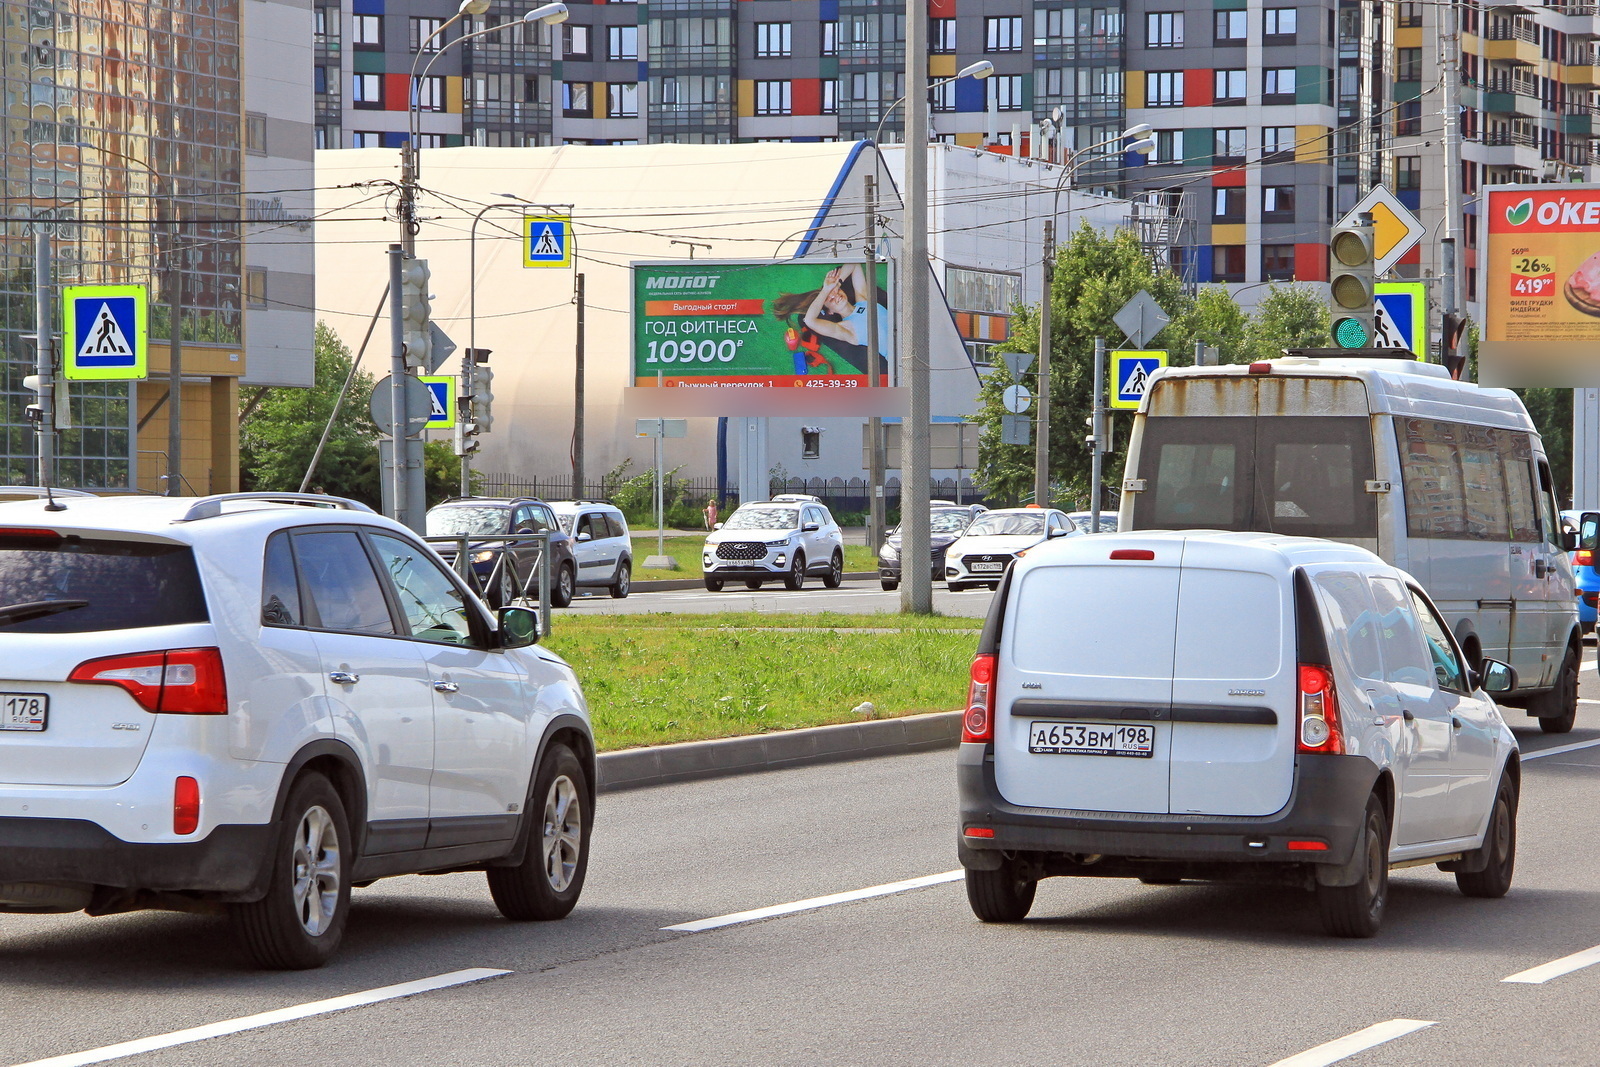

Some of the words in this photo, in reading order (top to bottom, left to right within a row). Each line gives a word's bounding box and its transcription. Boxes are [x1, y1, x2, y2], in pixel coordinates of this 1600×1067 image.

[1516, 258, 1550, 272] -26%
[645, 275, 721, 289] МОЛОТ
[673, 303, 712, 311] Выгодный
[714, 303, 737, 312] старт!
[645, 321, 677, 337] ГОД
[680, 320, 759, 335] ФИТНЕСА
[805, 379, 858, 387] 425-39-39
[1228, 688, 1265, 696] LARGUS
[7, 698, 39, 716] 178
[1036, 726, 1113, 748] А653ВМ
[1117, 728, 1147, 744] 198
